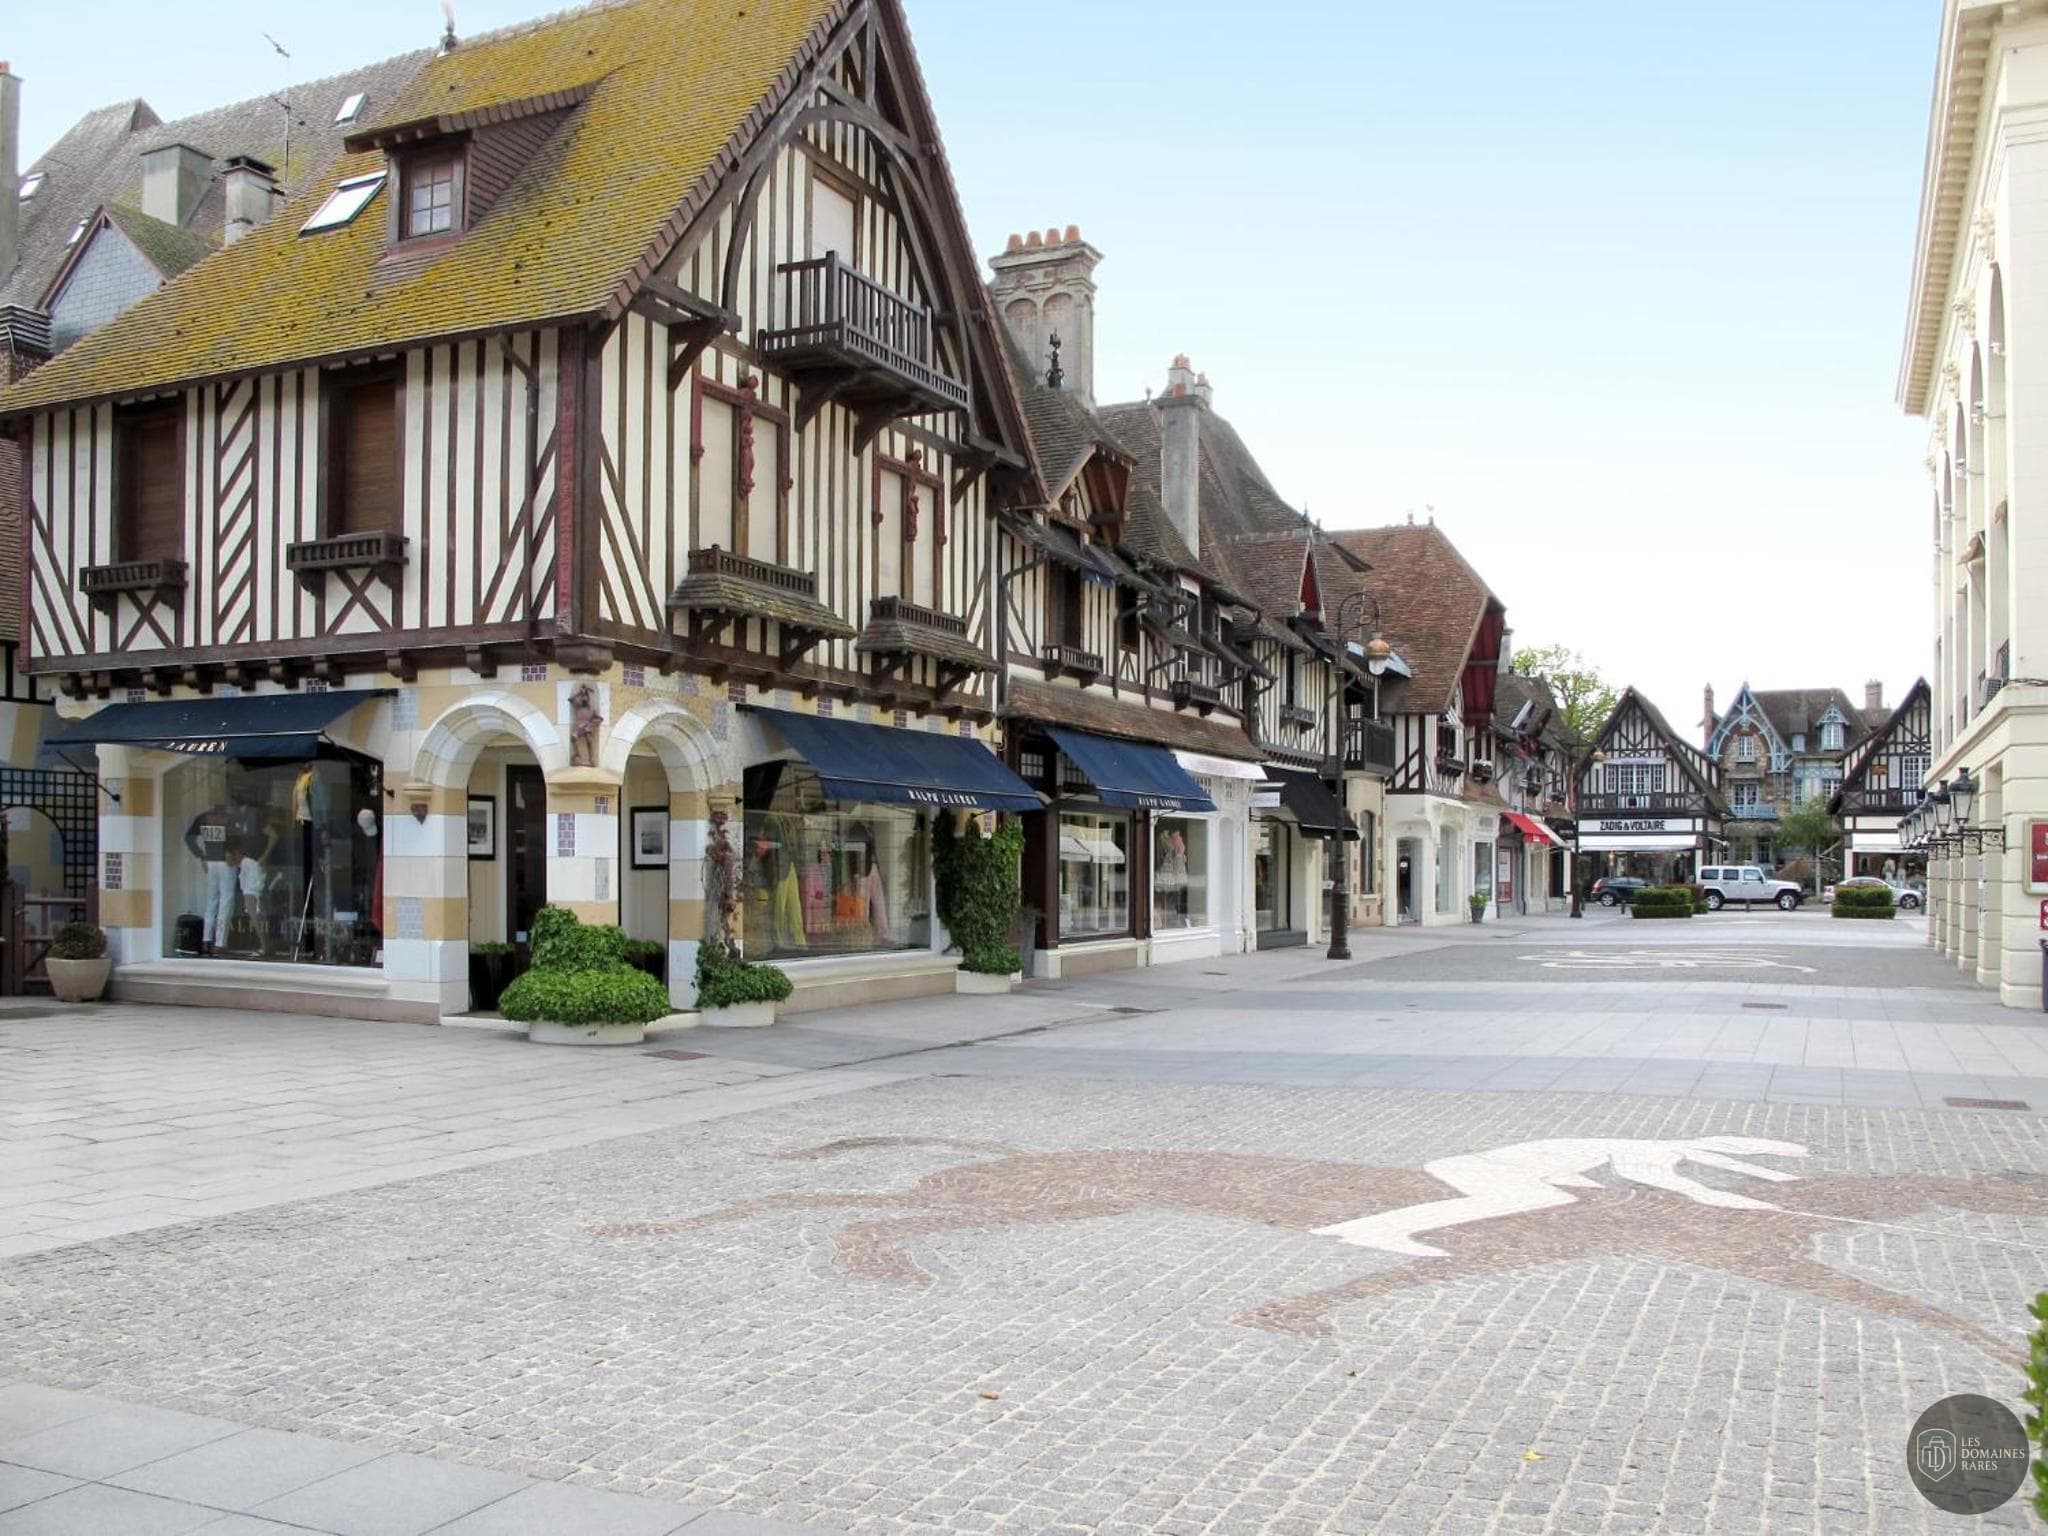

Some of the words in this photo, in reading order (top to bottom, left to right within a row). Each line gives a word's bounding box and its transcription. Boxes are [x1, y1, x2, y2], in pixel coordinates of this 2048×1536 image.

[166, 741, 228, 752] LAUREN
[1600, 821, 1622, 831] ZADIG
[1630, 820, 1665, 831] VOLTAIRE
